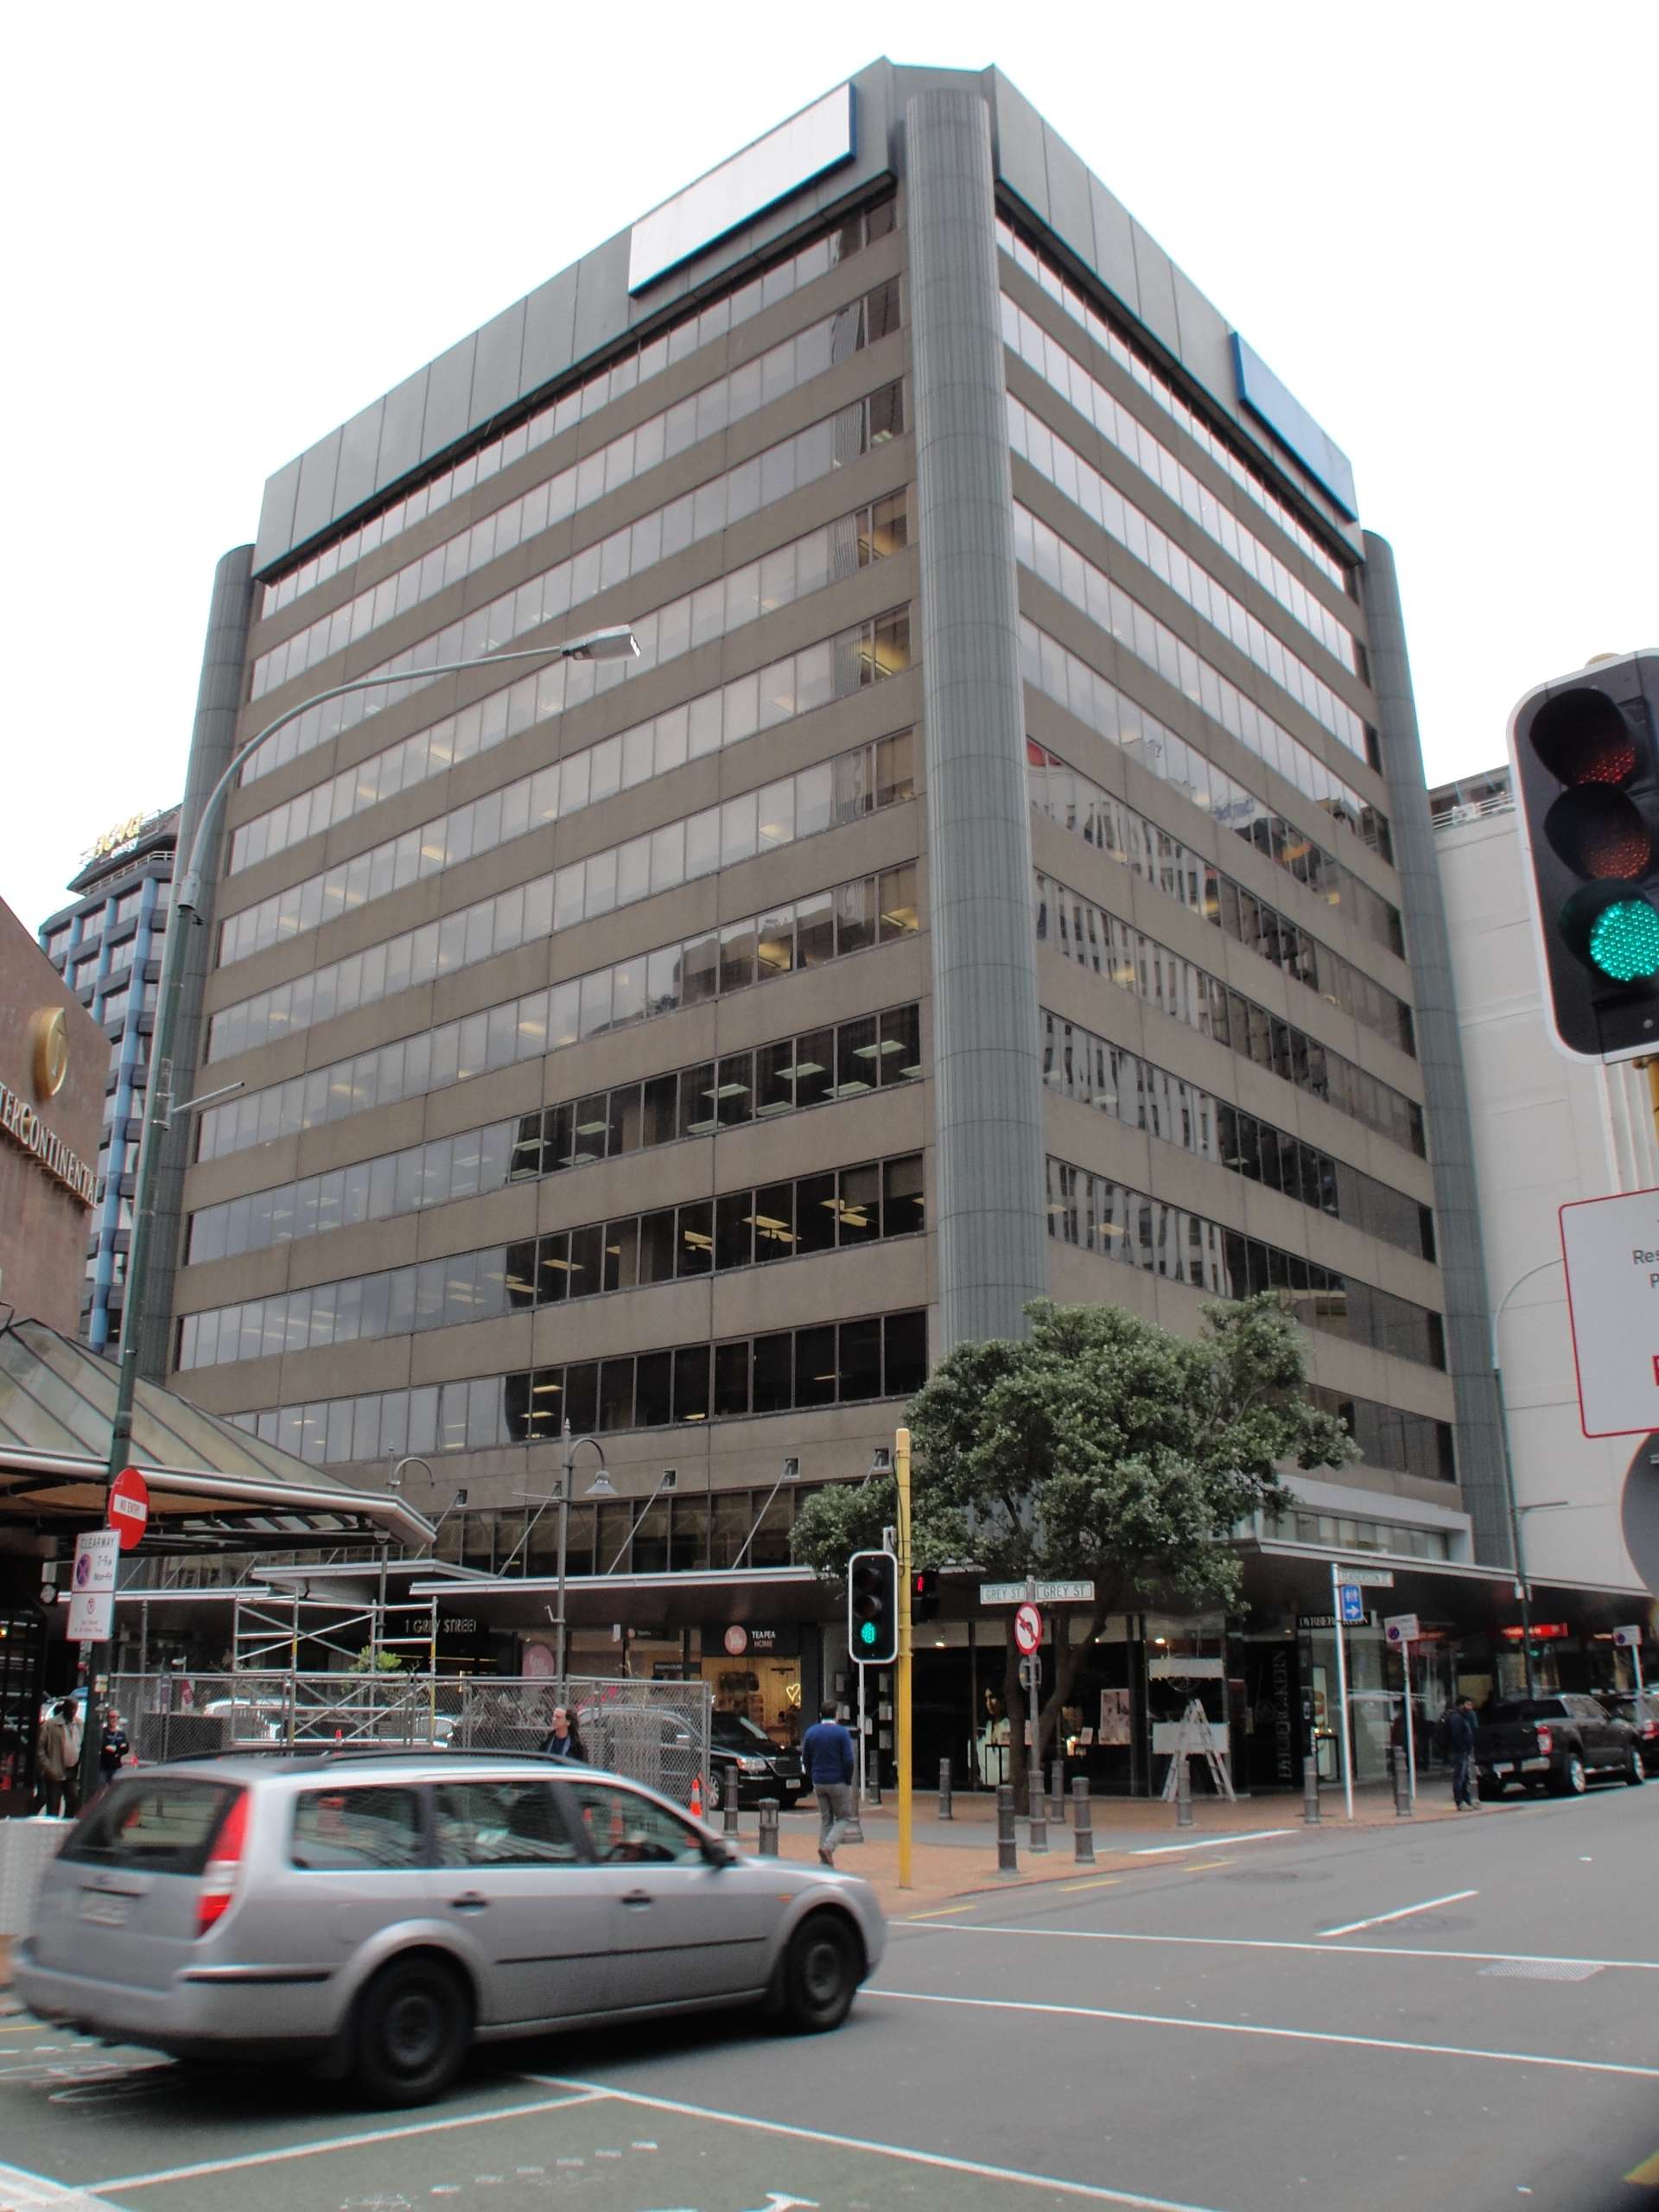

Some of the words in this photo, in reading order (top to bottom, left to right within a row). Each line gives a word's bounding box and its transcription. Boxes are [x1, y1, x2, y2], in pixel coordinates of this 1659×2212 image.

[120, 1499, 126, 1511] NO
[127, 1501, 141, 1514] ENTRY
[80, 1535, 116, 1549] CLEARWAY
[987, 1589, 1007, 1600] GREY
[1012, 1588, 1020, 1599] ST
[1044, 1586, 1067, 1598] GREY
[1073, 1585, 1085, 1597] ST
[405, 1618, 410, 1633] 1
[414, 1619, 441, 1633] GRY
[443, 1618, 476, 1633] STREET
